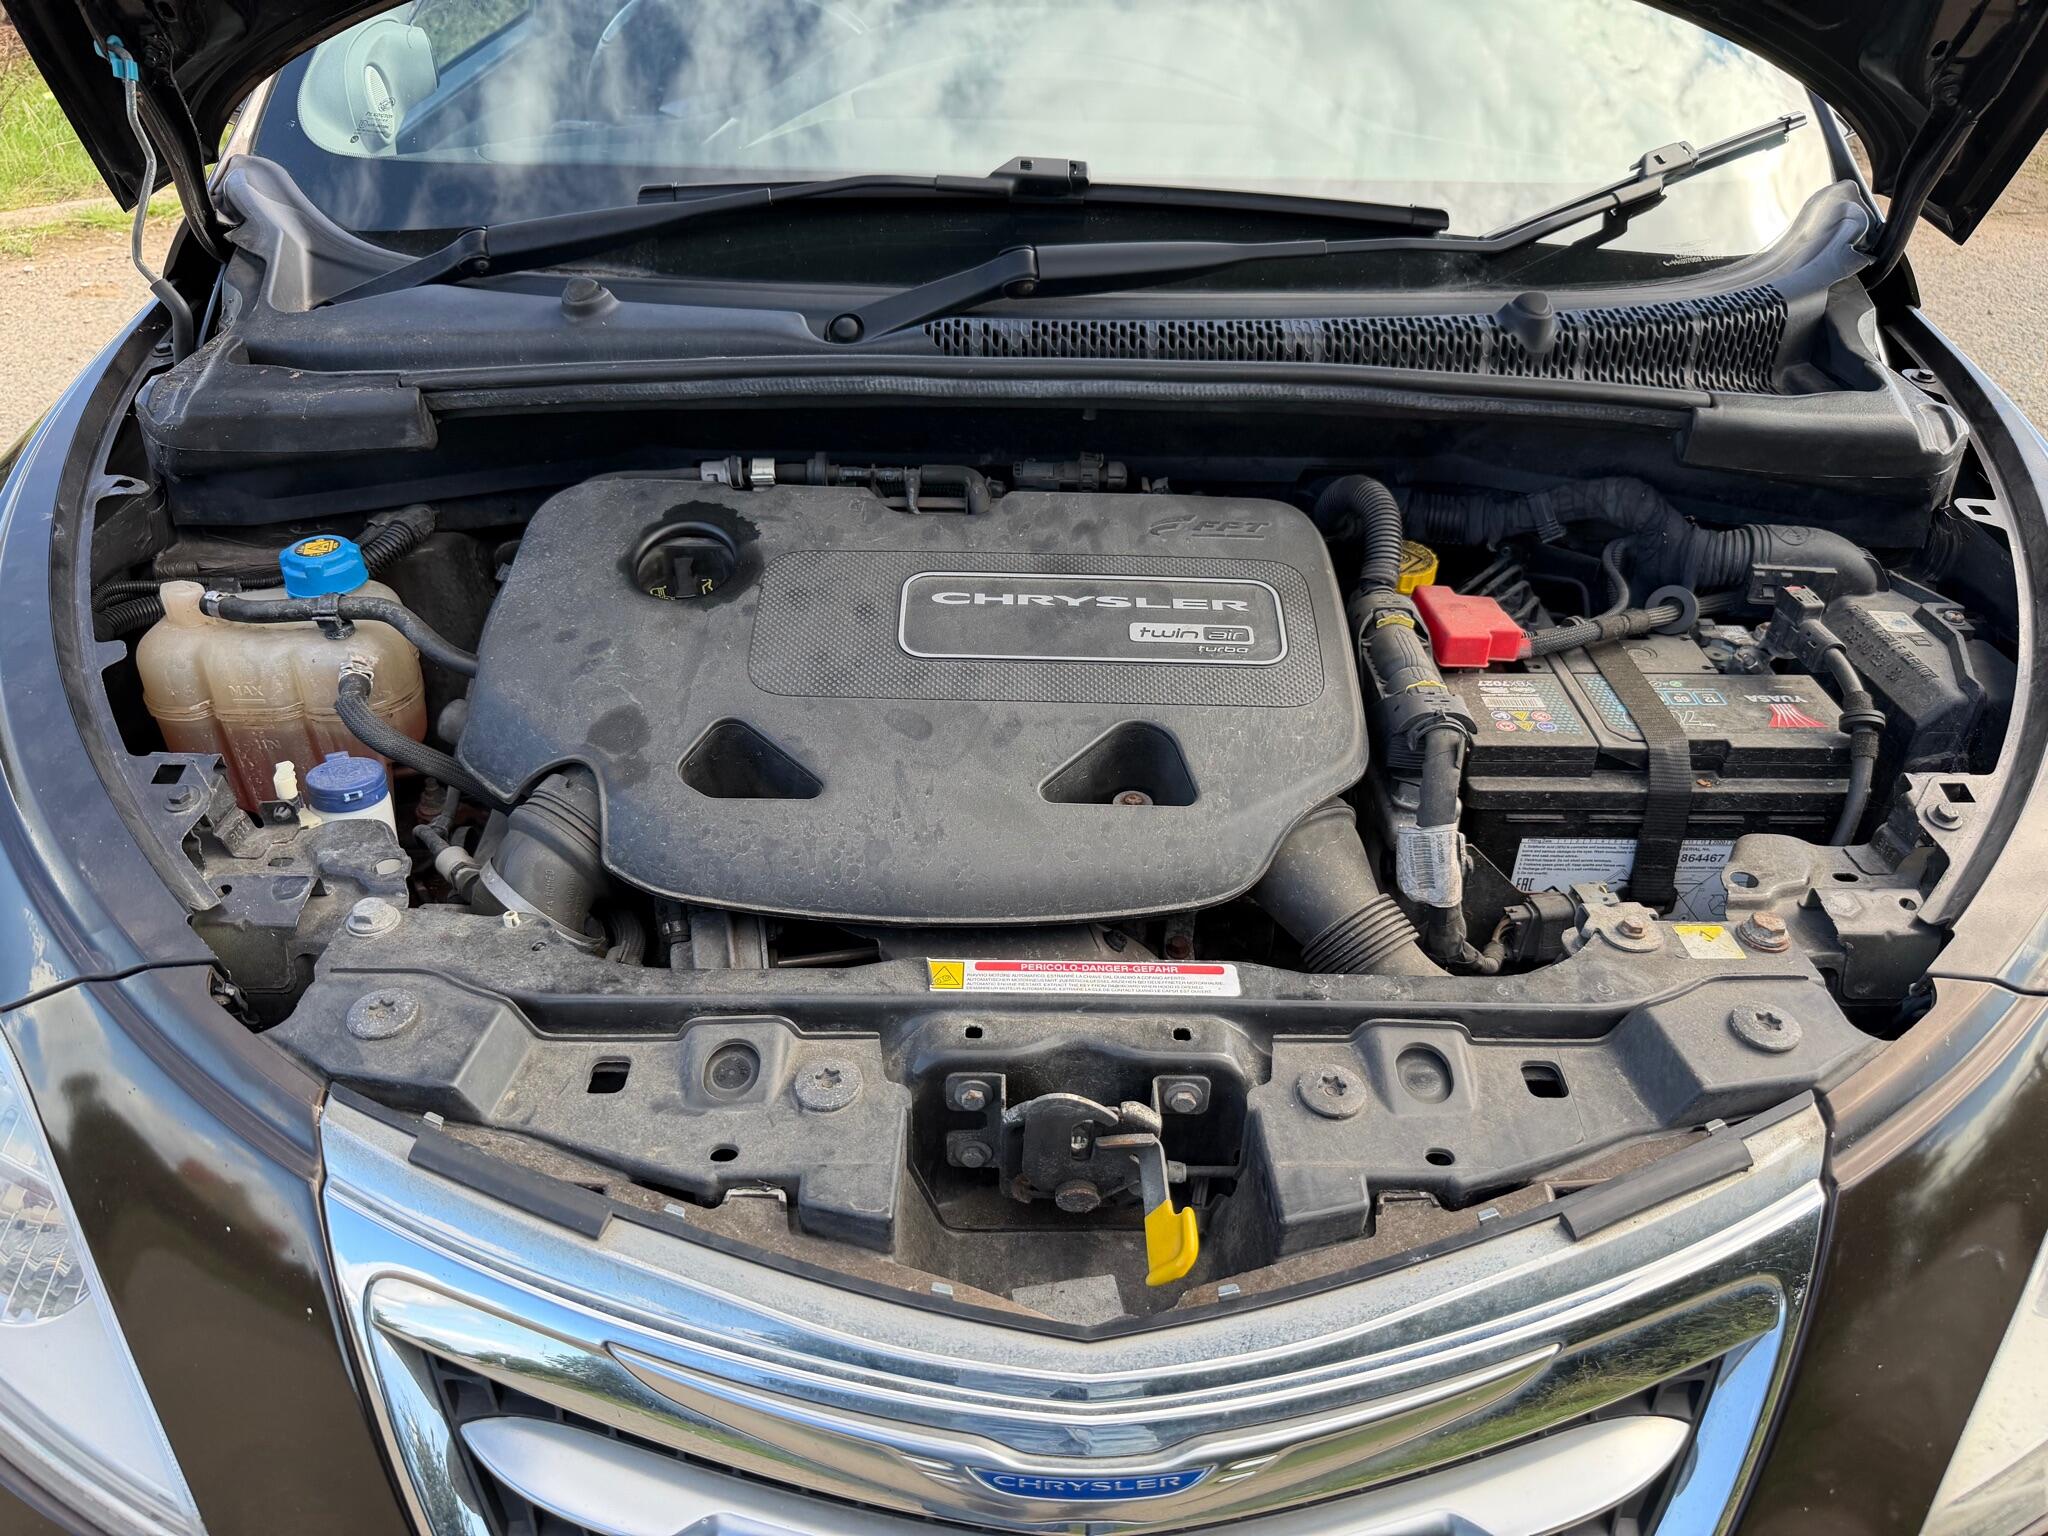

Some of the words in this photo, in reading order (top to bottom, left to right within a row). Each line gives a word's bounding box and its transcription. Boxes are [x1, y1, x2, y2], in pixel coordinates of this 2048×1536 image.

[931, 592, 1250, 612] CHRYSLER
[1139, 626, 1200, 640] twin
[1207, 627, 1244, 641] air
[1197, 645, 1249, 654] turbo
[228, 685, 263, 697] MAX
[1743, 694, 1808, 704] YUASA
[1680, 853, 1725, 863] 864467
[1020, 963, 1179, 973] PERICOLO-DANGER-GEFAHR
[992, 1476, 1181, 1491] CHRYSLER
